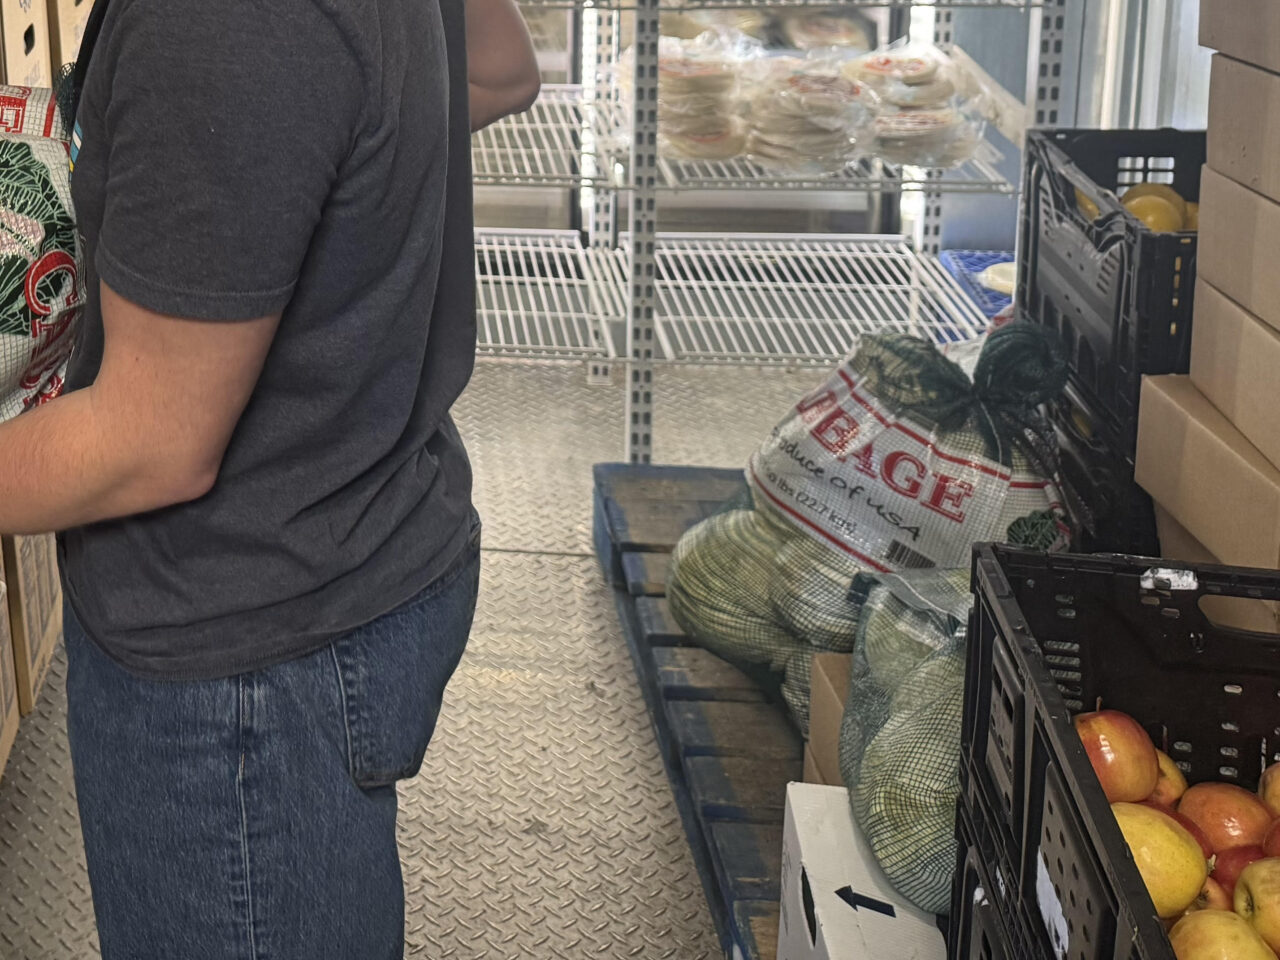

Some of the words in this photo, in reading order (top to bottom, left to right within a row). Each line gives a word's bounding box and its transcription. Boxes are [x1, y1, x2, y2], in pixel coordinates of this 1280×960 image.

[775, 479, 796, 497] lbs
[829, 476, 867, 501] of
[866, 495, 922, 542] USA
